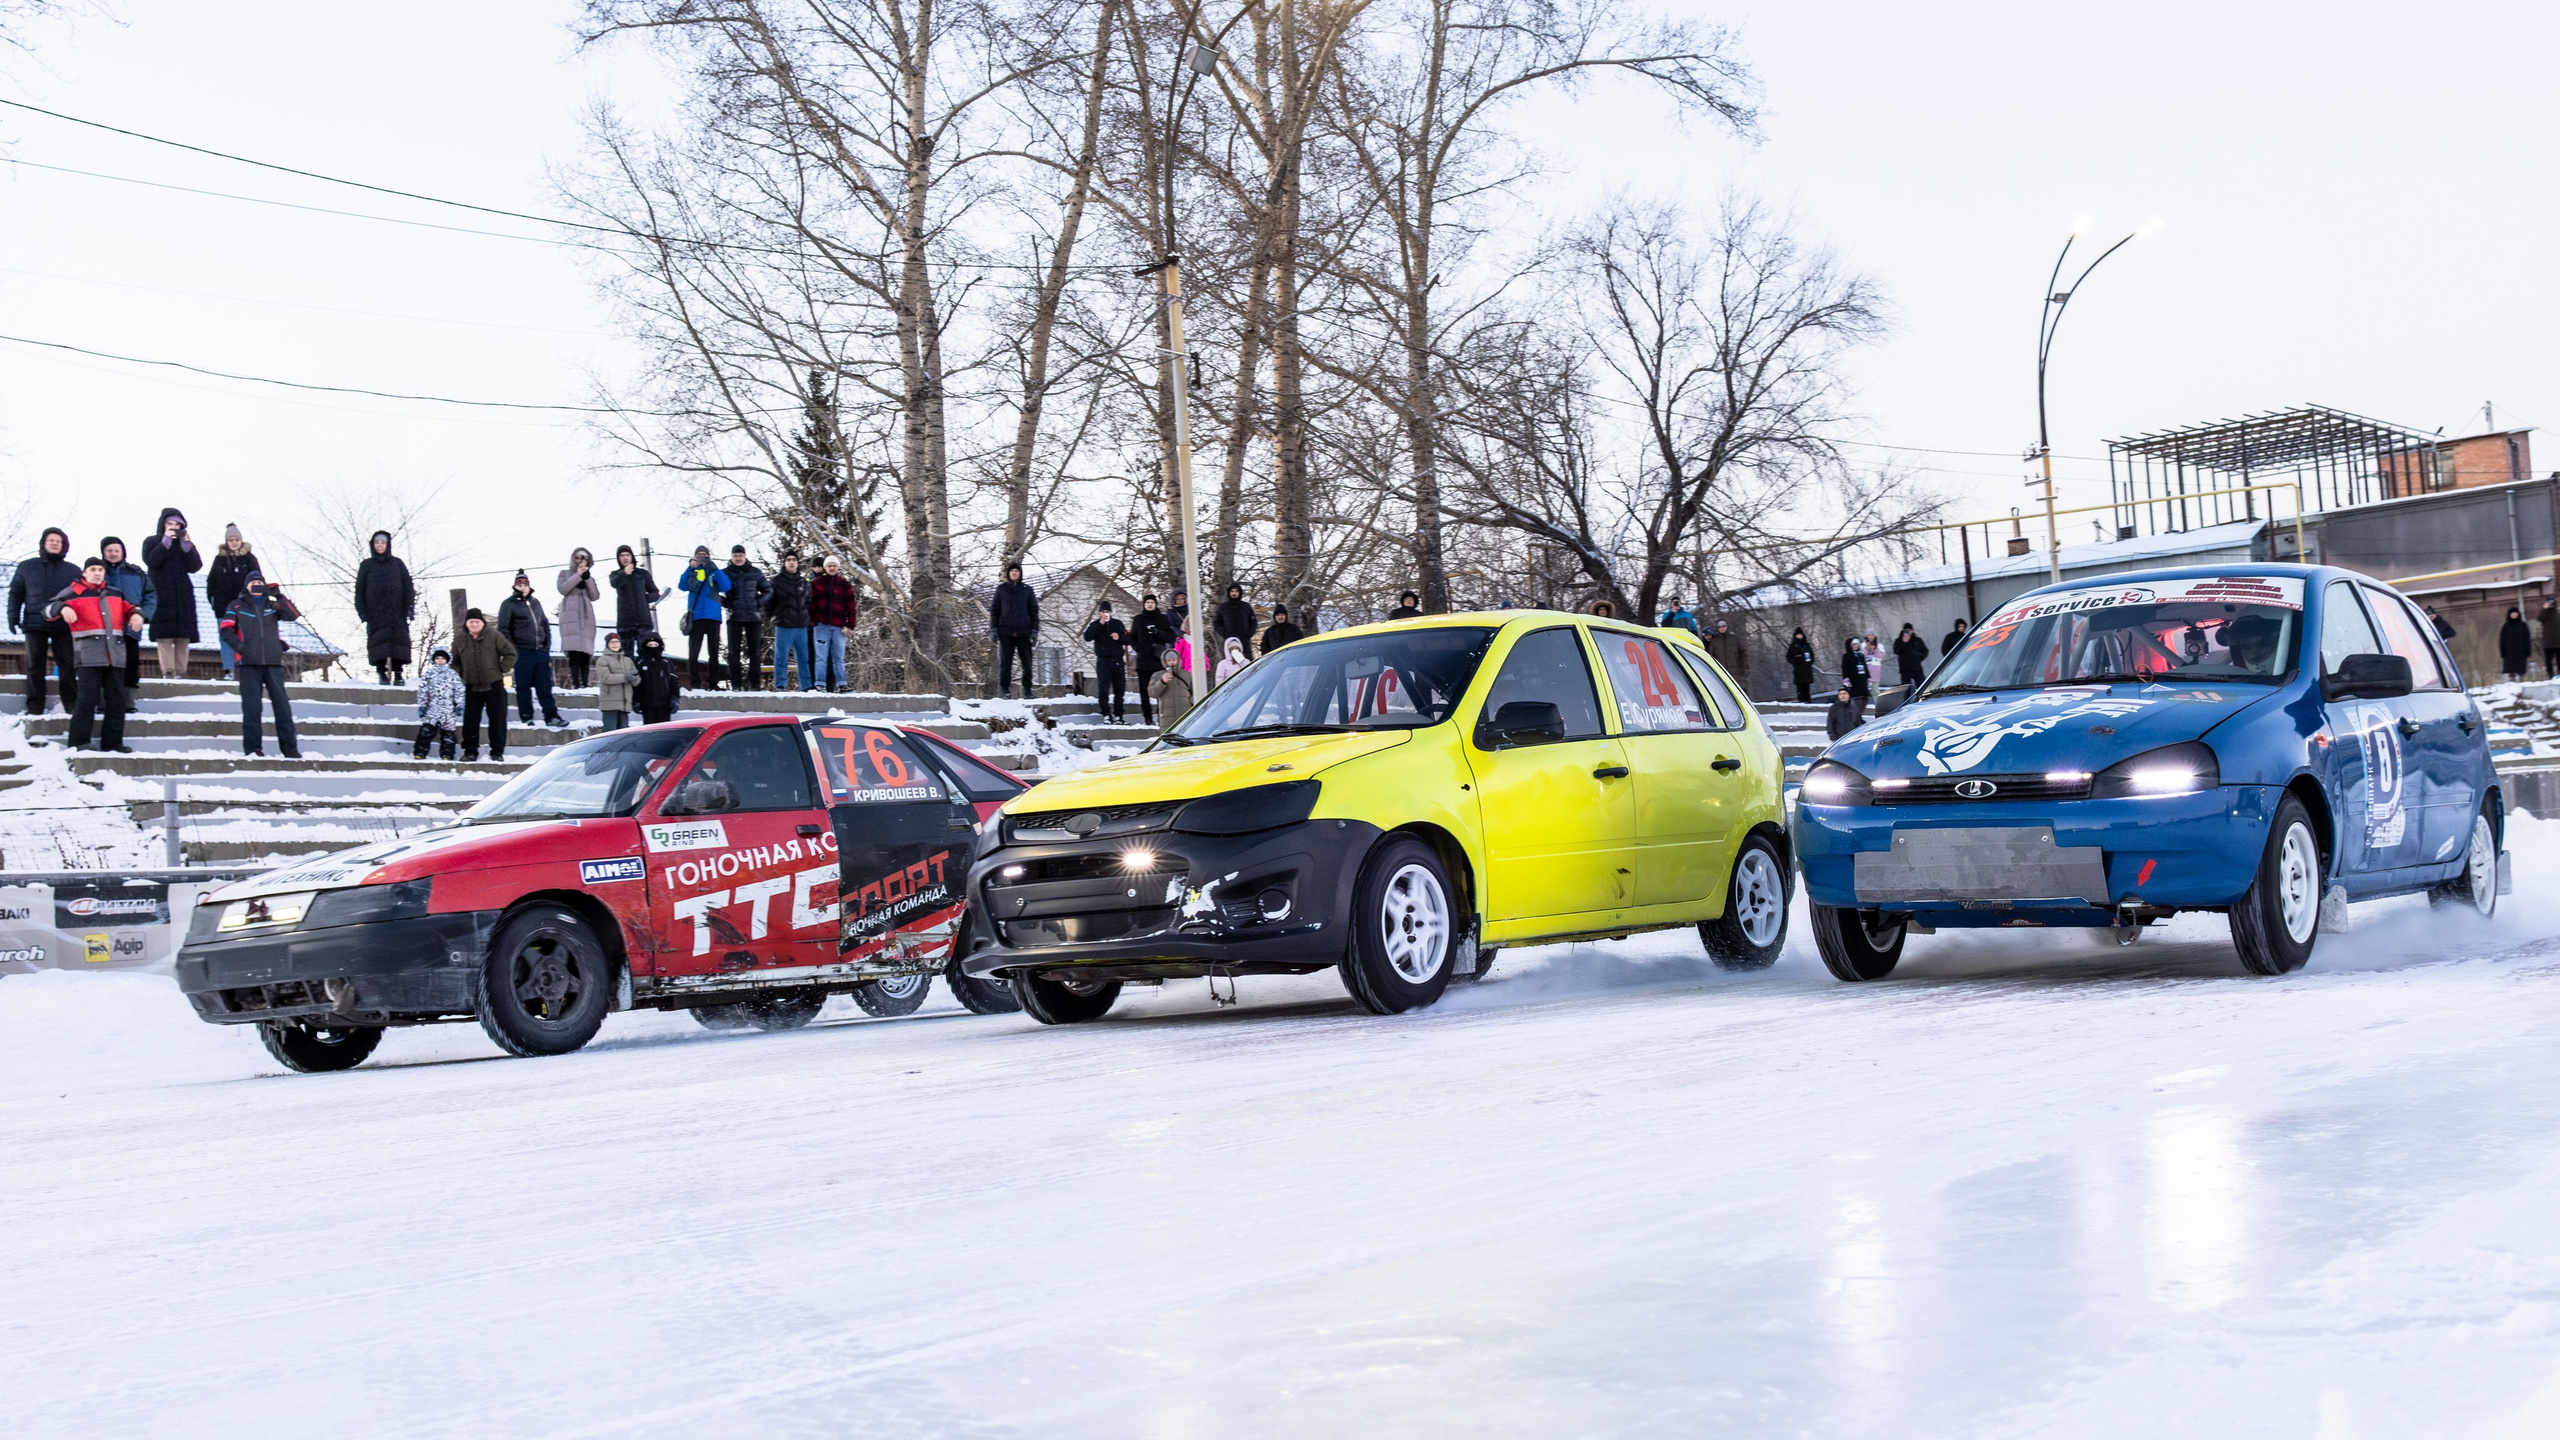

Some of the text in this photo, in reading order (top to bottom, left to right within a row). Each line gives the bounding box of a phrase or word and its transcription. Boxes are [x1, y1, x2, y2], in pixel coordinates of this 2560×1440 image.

[1966, 624, 2019, 652] 23
[1624, 640, 1681, 707] 24
[820, 727, 908, 788] 76
[853, 785, 942, 802] КРИВОШЕЕВ В.
[671, 839, 695, 847] RING
[672, 828, 719, 840] GREEN
[584, 861, 642, 880] AIMOL
[664, 841, 802, 889] ГОНОЧНАЯ
[894, 884, 948, 912] КОМАНДА
[113, 937, 144, 955] Agip
